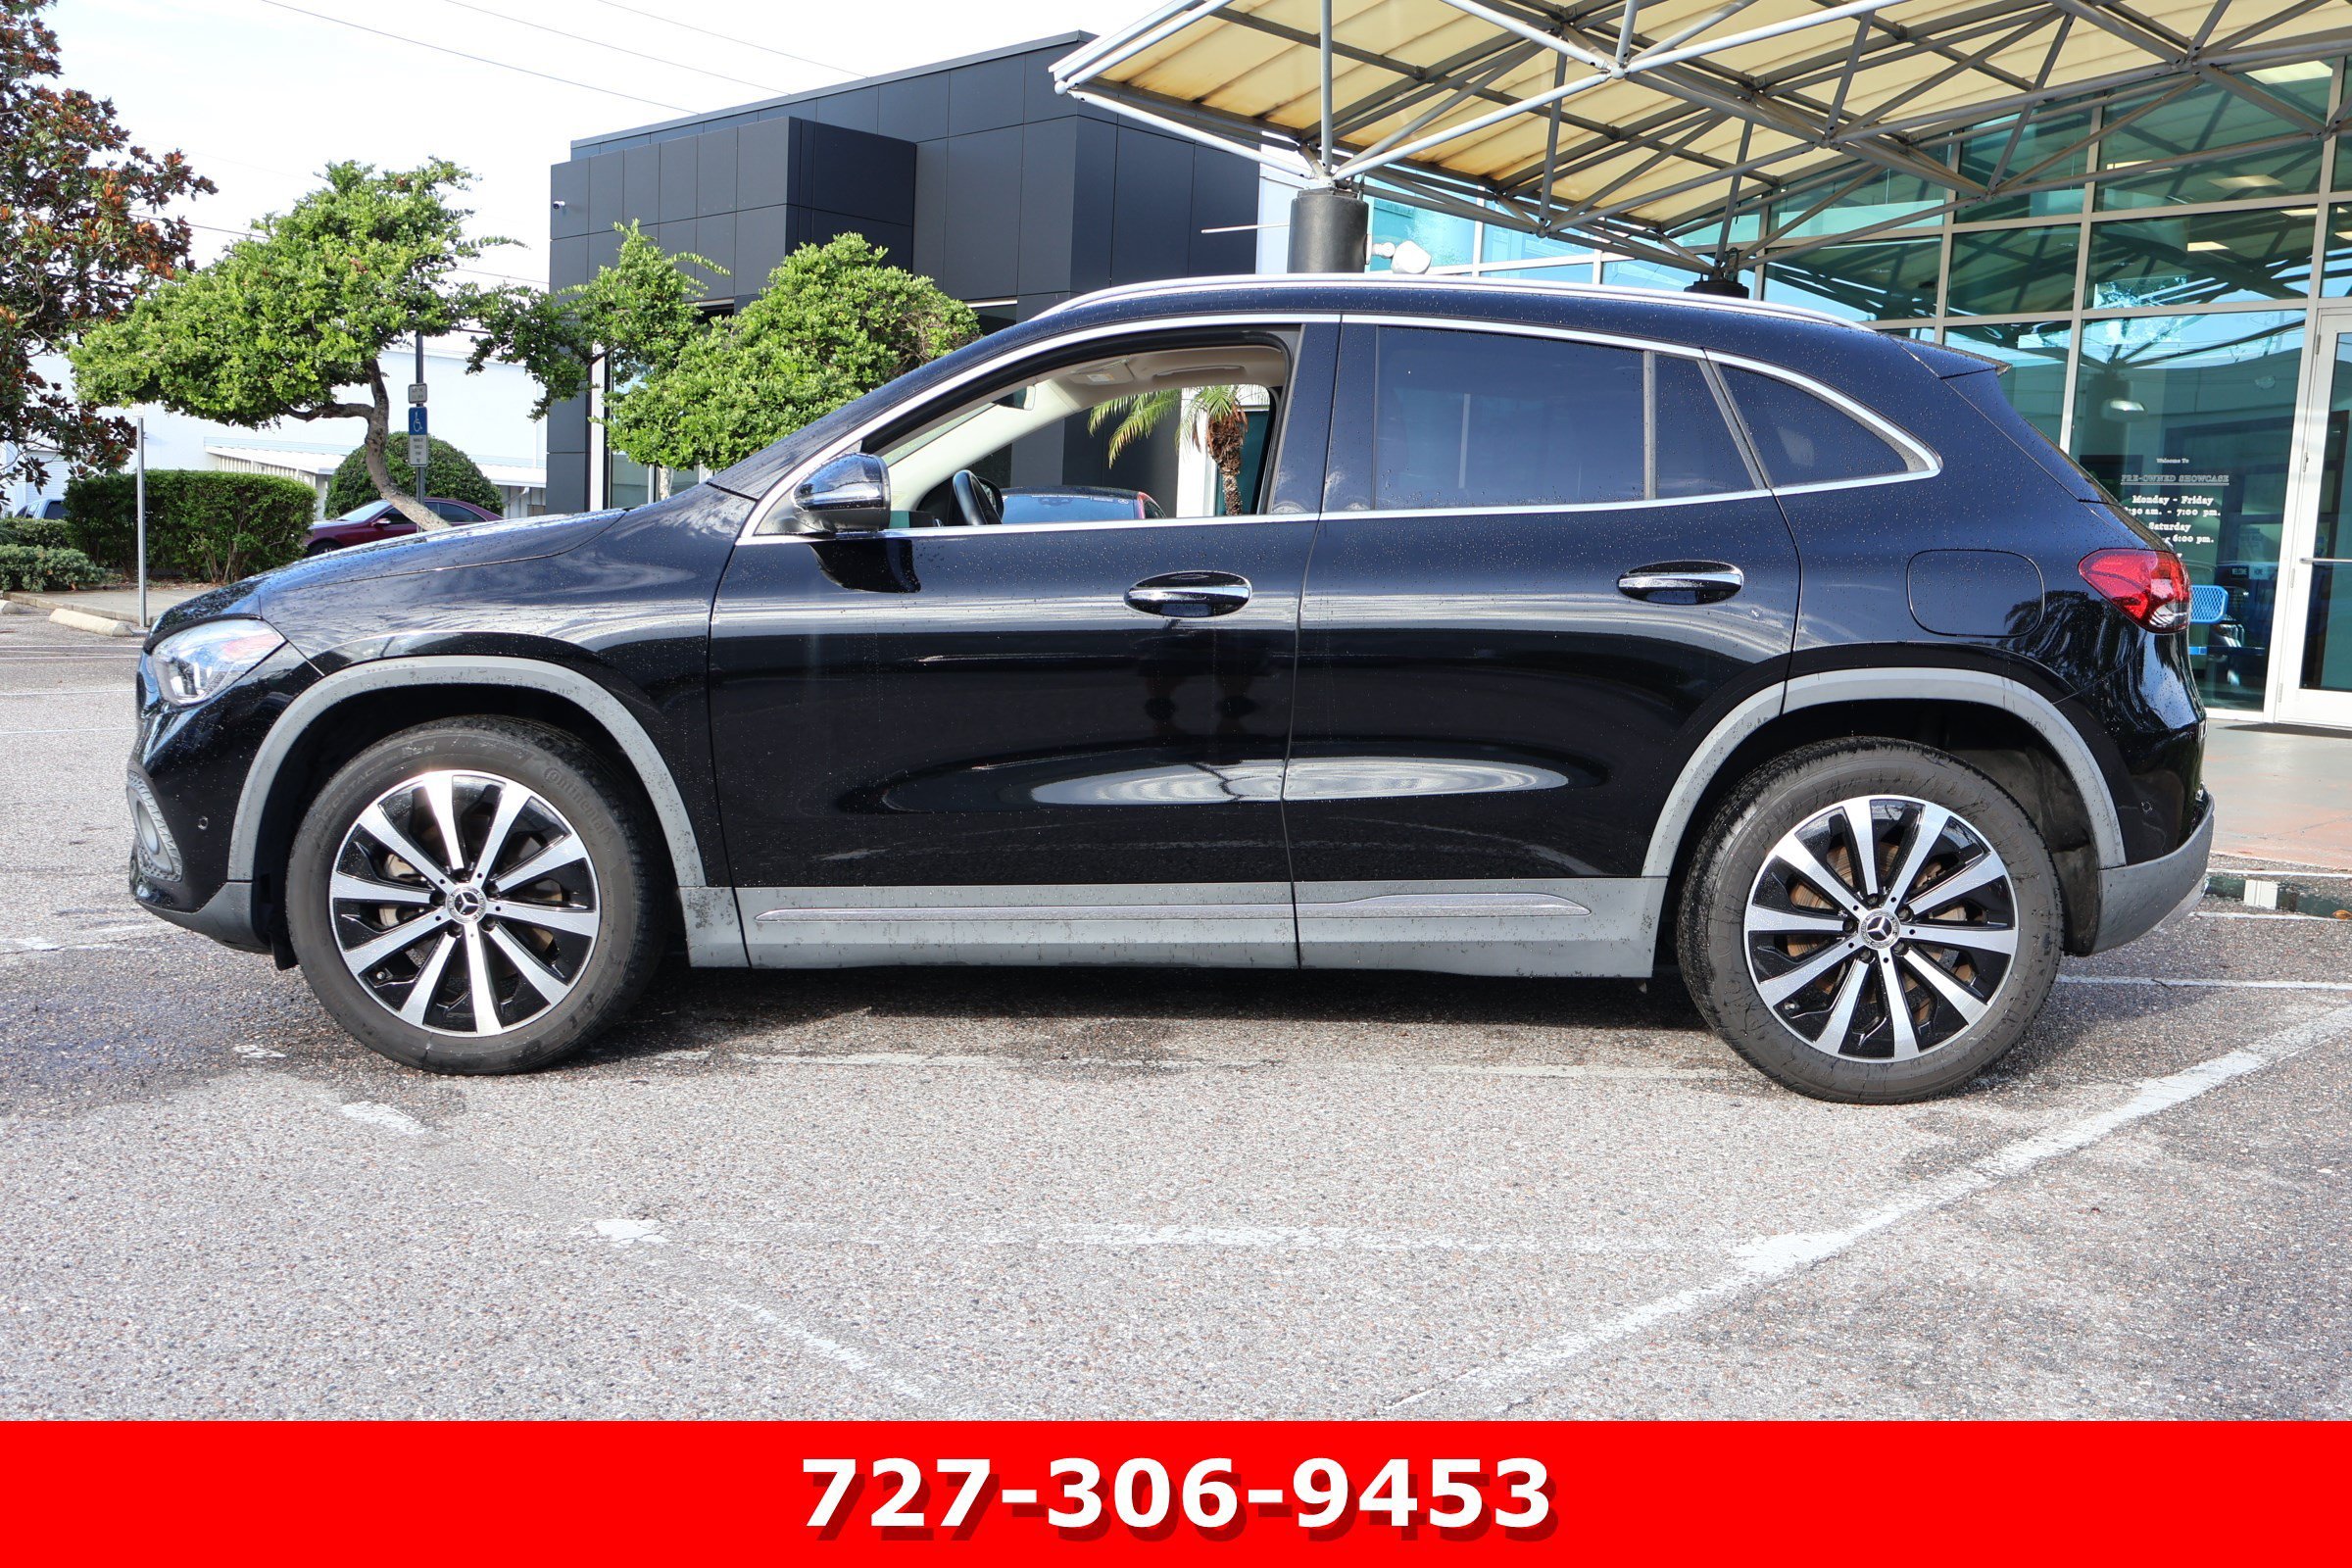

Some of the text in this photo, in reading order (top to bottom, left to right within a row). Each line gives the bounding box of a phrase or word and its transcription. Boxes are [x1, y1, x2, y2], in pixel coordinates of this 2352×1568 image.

[2179, 474, 2230, 483] SHOWCASE
[2132, 495, 2170, 505] Monday
[2180, 495, 2214, 506] Friday
[2148, 522, 2191, 532] Saturday
[2196, 535, 2214, 544] pm.
